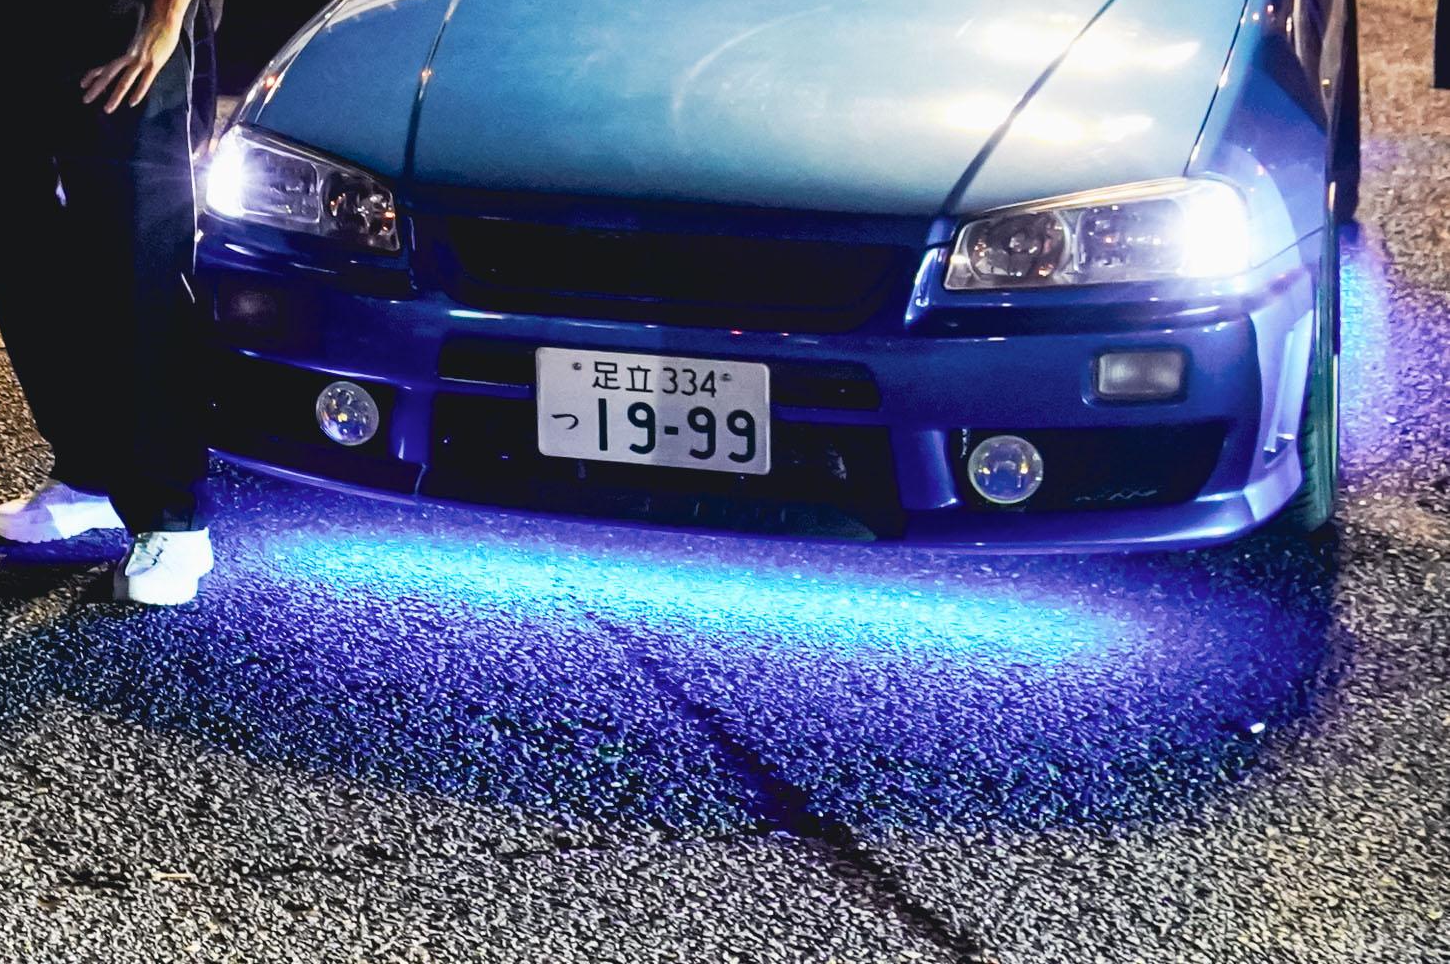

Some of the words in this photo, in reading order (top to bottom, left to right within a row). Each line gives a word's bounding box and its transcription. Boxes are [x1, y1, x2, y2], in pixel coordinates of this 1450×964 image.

[592, 361, 654, 394] 足立
[661, 367, 717, 398] 334
[551, 412, 579, 430] つ
[597, 397, 757, 464] 19-99
